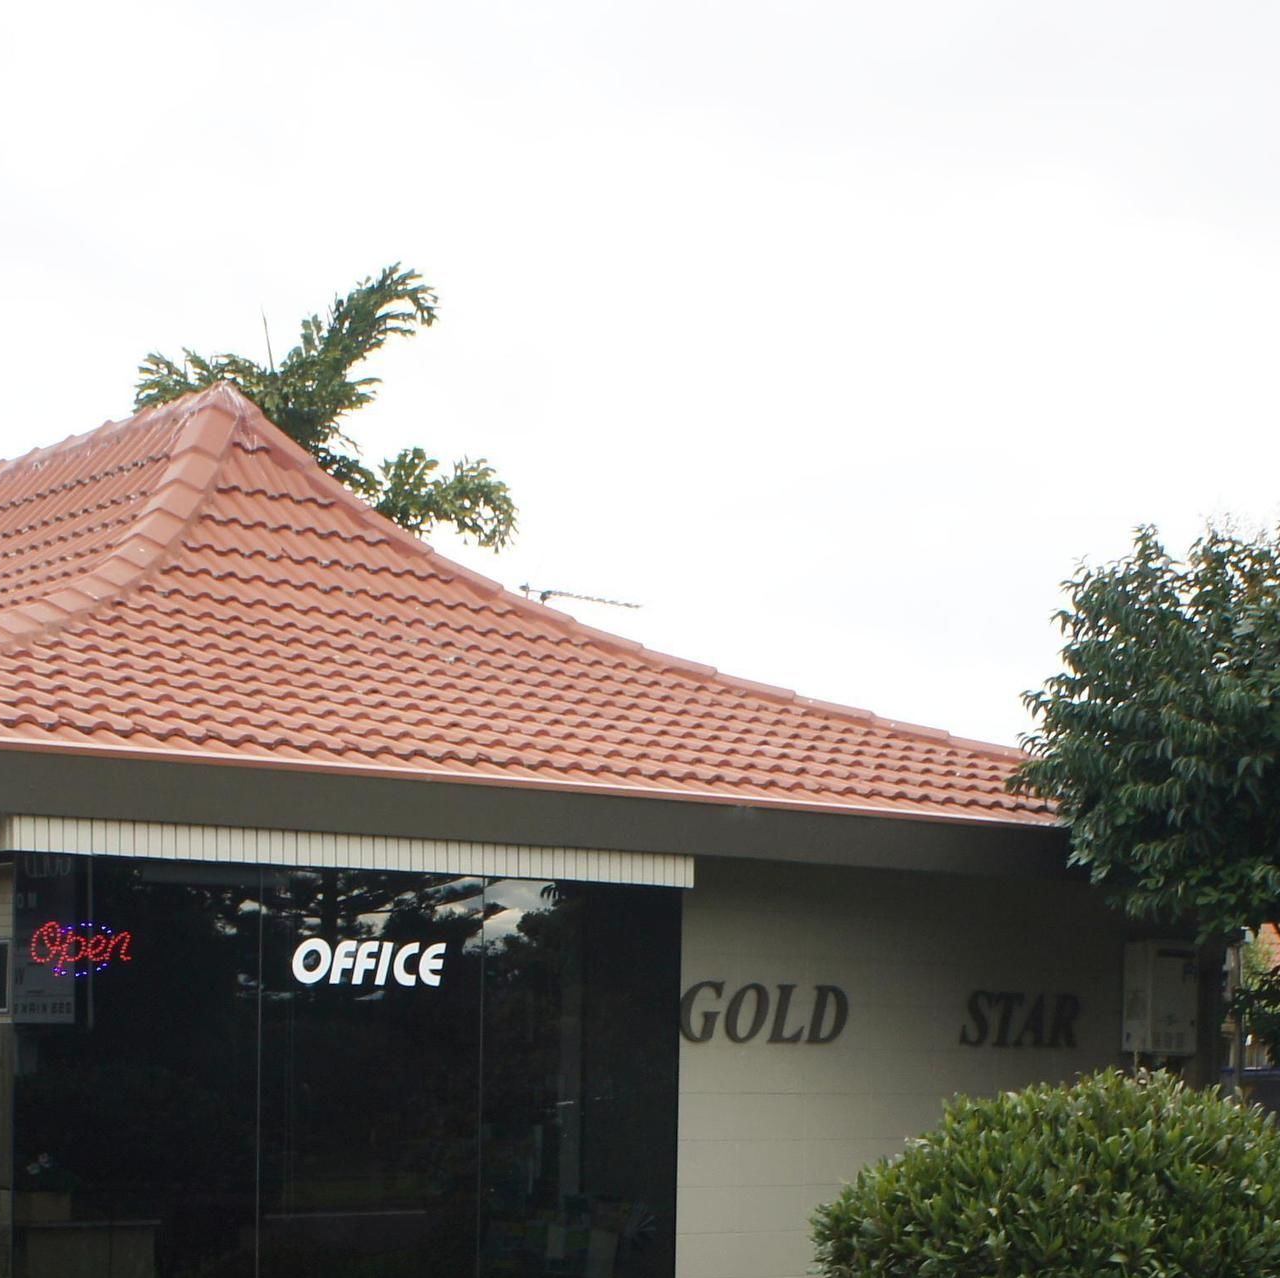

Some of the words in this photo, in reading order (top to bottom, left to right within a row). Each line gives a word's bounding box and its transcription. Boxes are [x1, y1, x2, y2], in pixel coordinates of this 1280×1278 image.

[31, 921, 133, 977] Open
[292, 938, 448, 988] OFFICE
[678, 980, 849, 1045] GOLD
[958, 990, 1081, 1049] STAR
